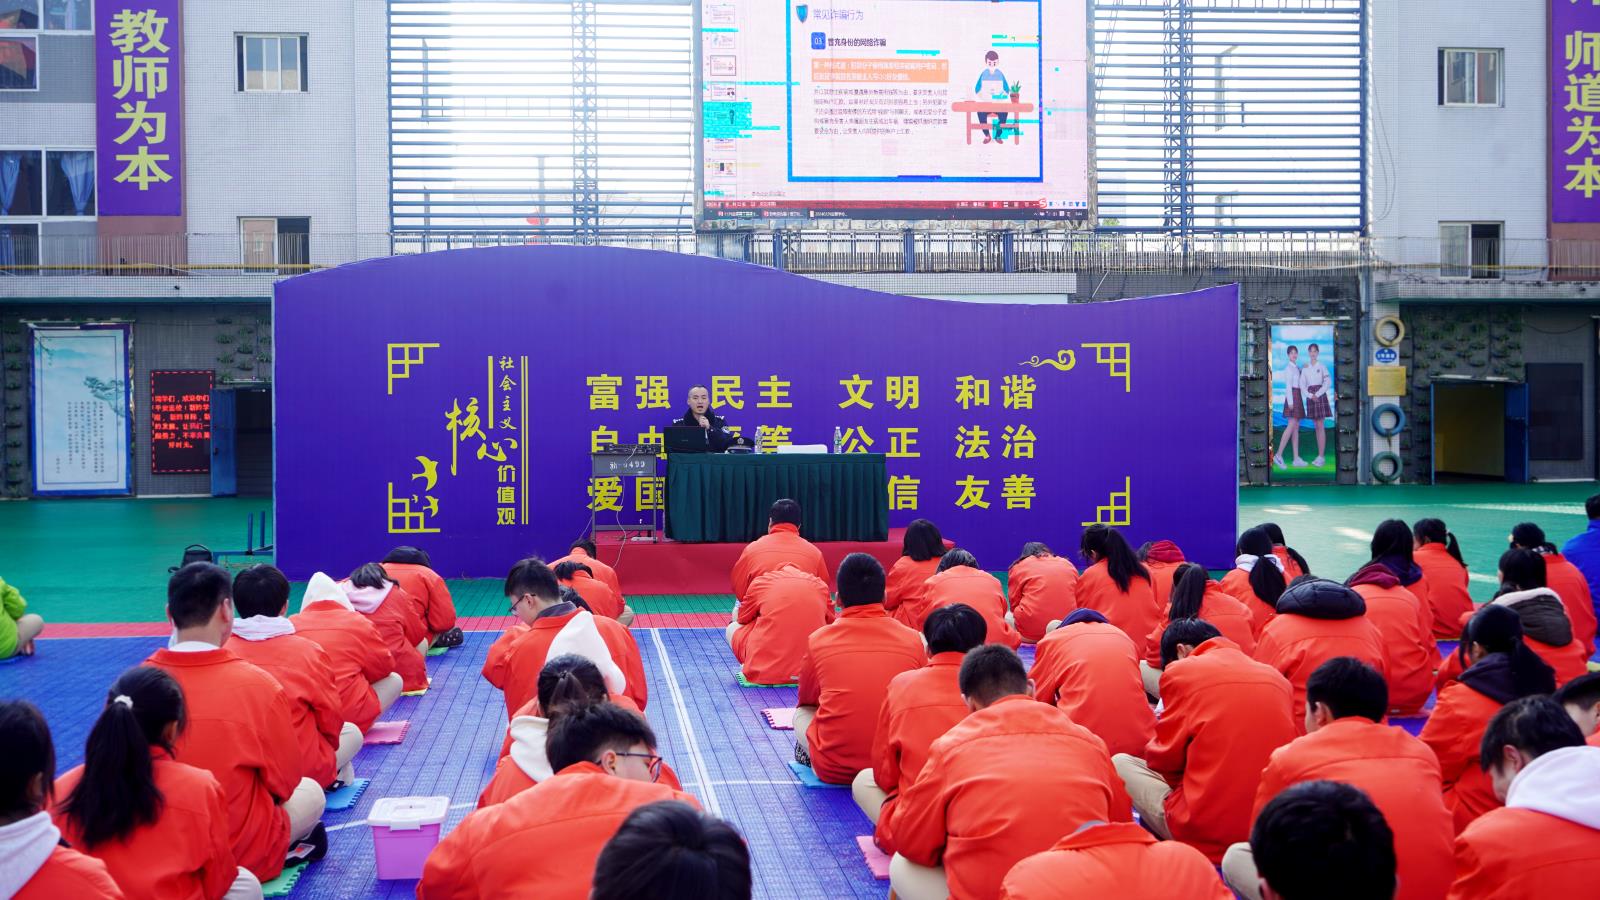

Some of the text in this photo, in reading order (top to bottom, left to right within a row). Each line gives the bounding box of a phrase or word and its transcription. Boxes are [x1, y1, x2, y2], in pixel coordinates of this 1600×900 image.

[813, 8, 864, 21] 常见诈骗行为
[814, 37, 823, 46] 03
[827, 38, 887, 47] 冒充身份的网络诈骗
[111, 9, 171, 190] 教师为本
[498, 355, 517, 430] 社会主义
[586, 374, 1037, 410] 富强 民主 文明 和谐
[445, 397, 518, 476] 核心
[841, 425, 920, 458] 公正
[956, 424, 1037, 459] 法治
[496, 464, 516, 525] 价值观
[587, 476, 666, 512] 爱国
[955, 473, 1036, 510] 友善
